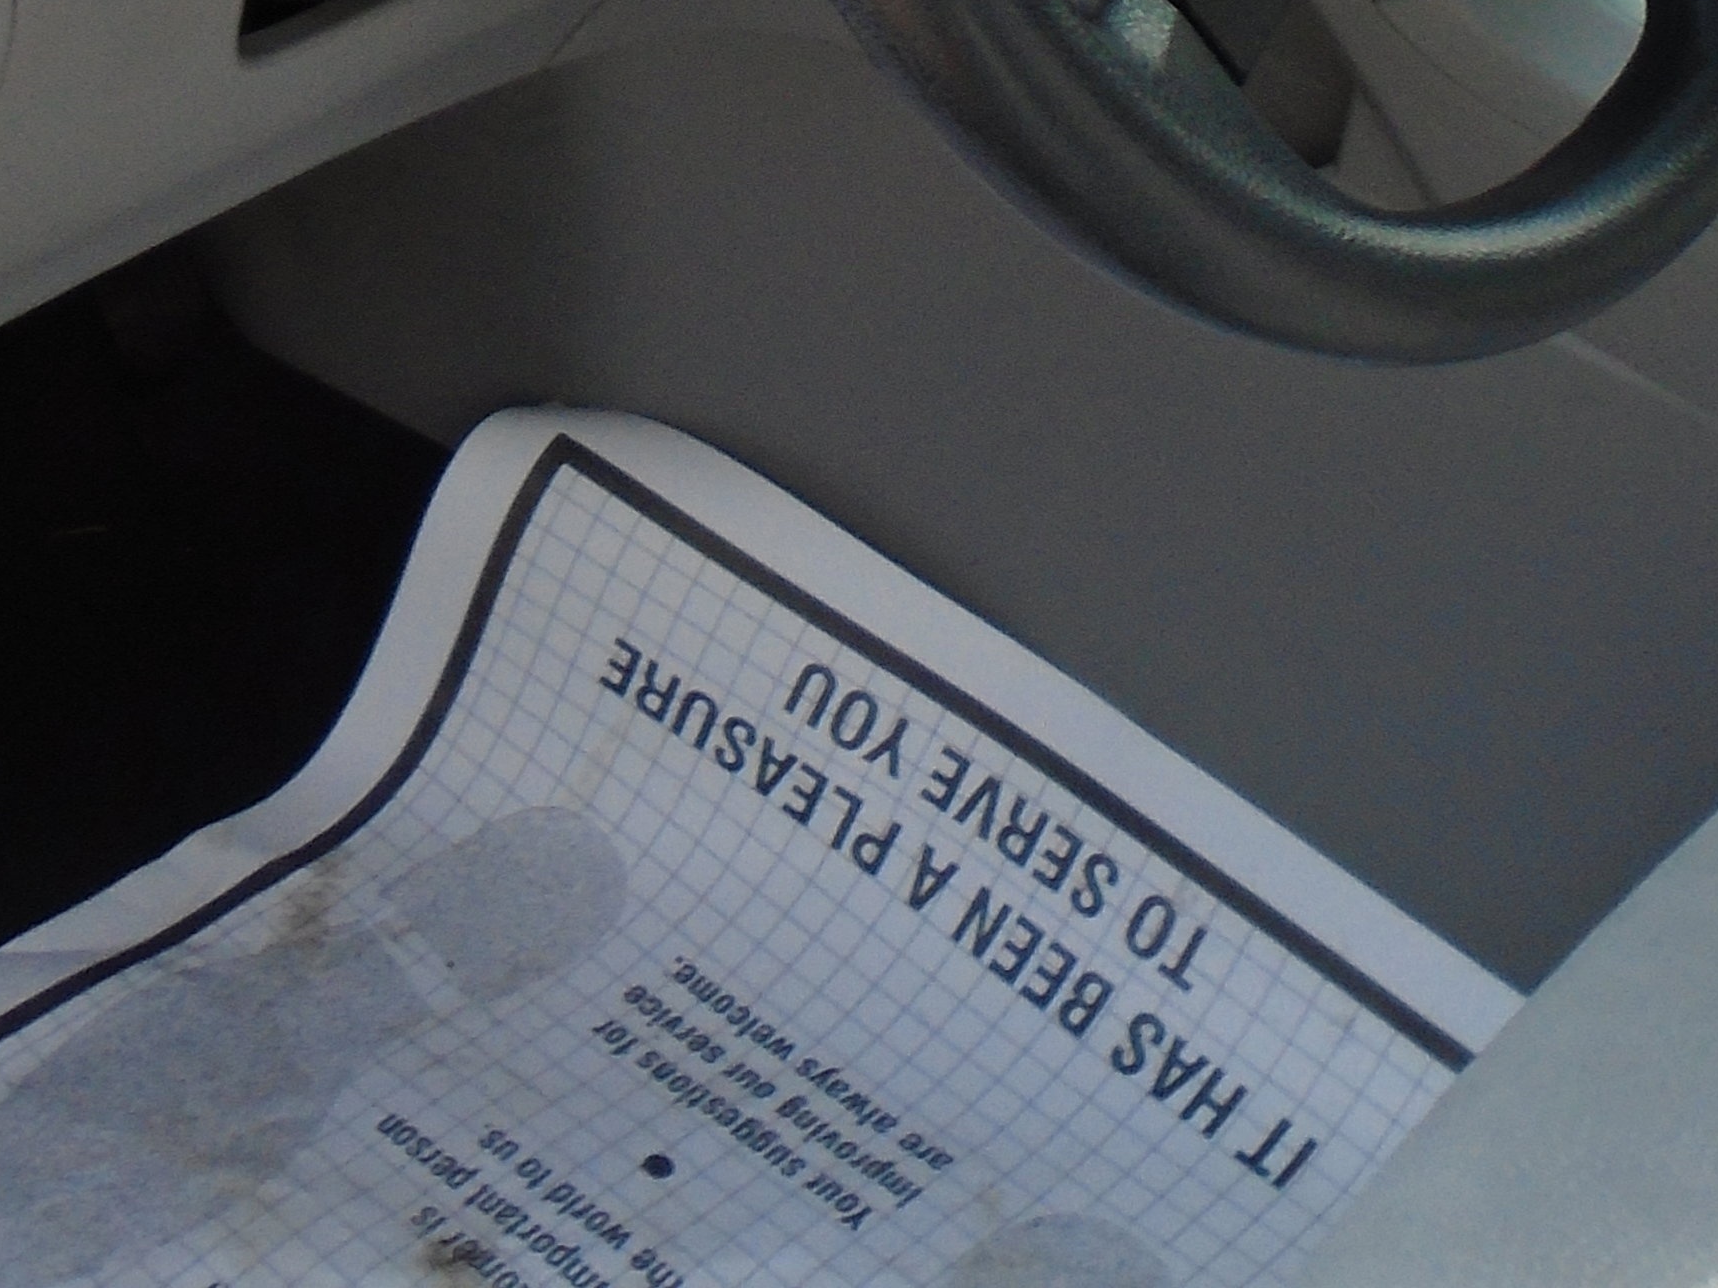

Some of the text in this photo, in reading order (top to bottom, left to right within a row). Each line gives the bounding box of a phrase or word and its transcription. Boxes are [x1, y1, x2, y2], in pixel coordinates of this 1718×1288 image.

[784, 662, 1209, 991] TO SERVE YOU
[598, 637, 1319, 1189] IT HAS BEEN A PLEASURE
[623, 985, 727, 1064] service
[671, 955, 954, 1171] are always welcome.
[722, 1062, 777, 1099] our
[376, 1112, 481, 1191] person
[591, 1019, 874, 1232] Your suggestions for
[514, 1156, 553, 1191] to
[409, 1205, 449, 1240] is
[541, 1181, 633, 1251] world
